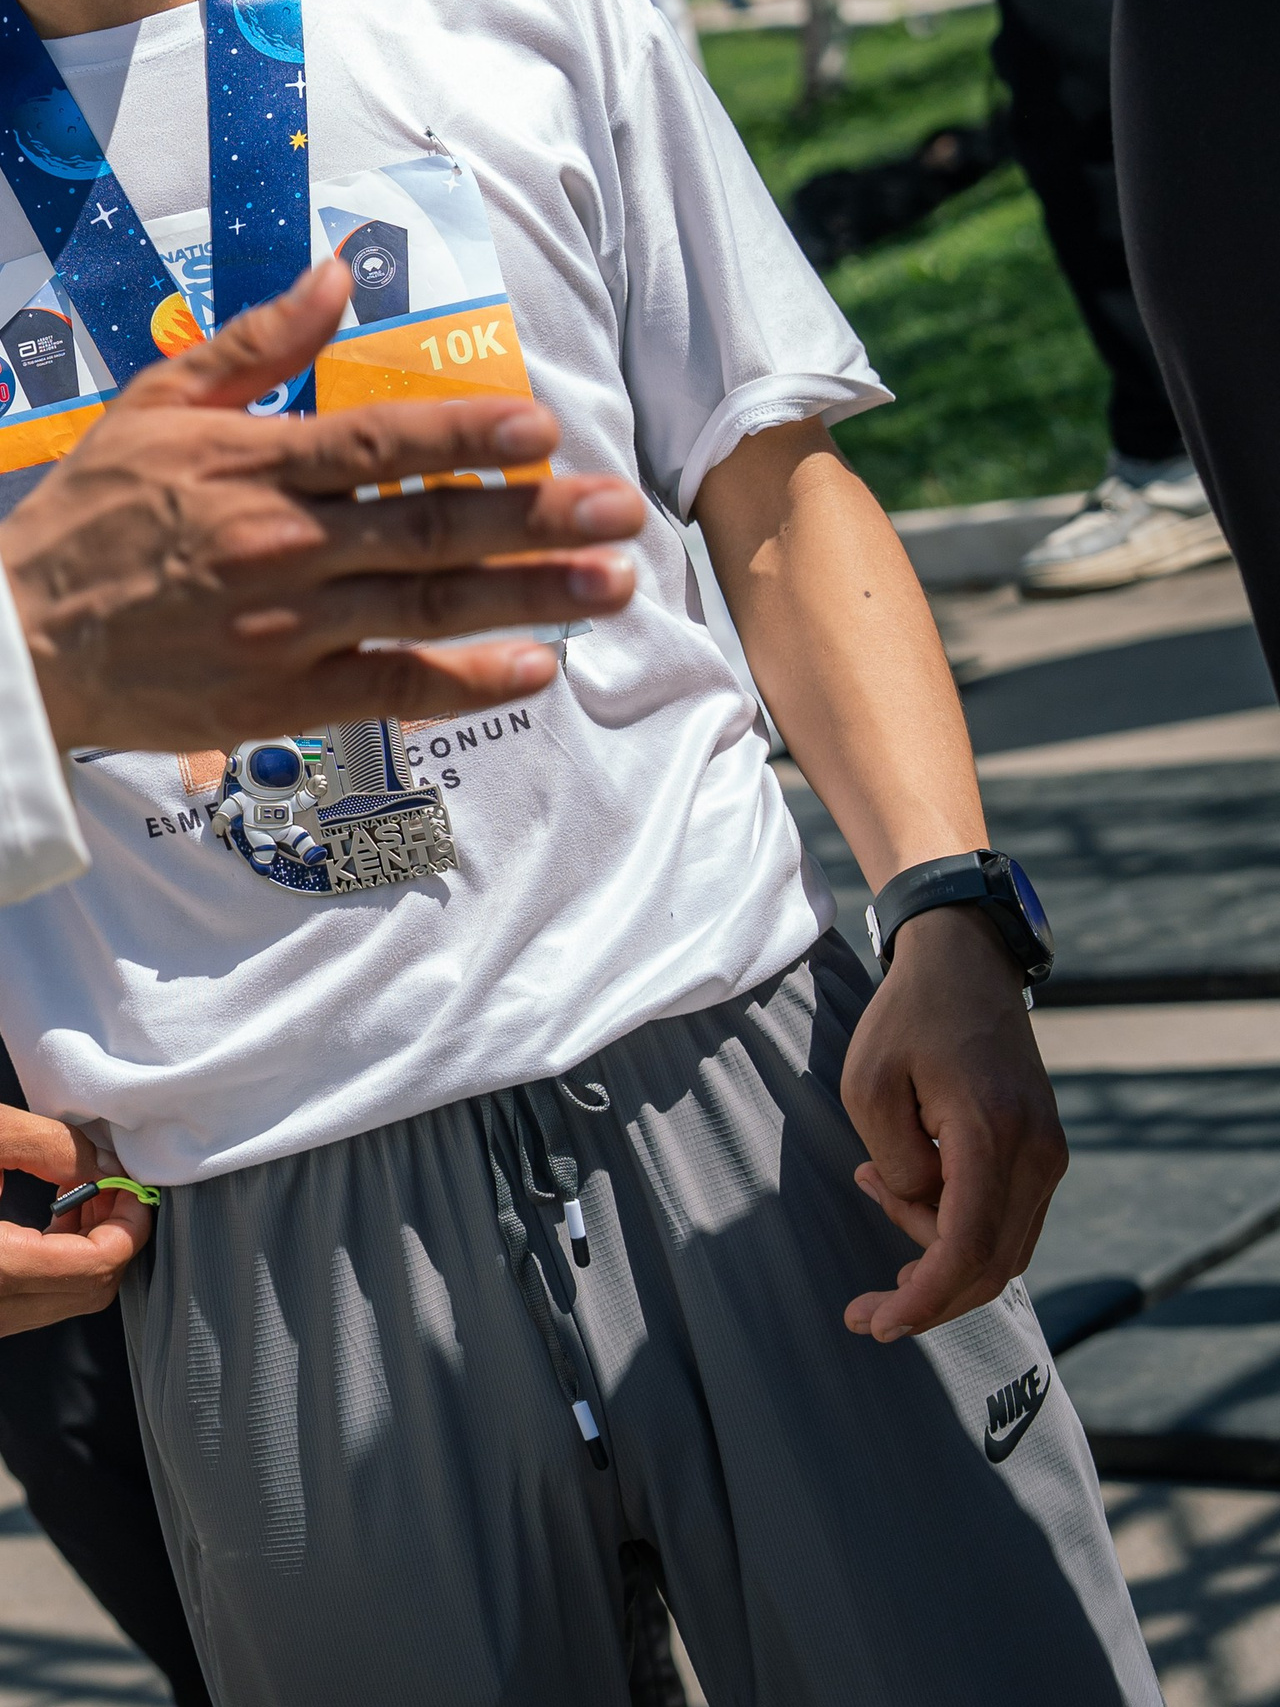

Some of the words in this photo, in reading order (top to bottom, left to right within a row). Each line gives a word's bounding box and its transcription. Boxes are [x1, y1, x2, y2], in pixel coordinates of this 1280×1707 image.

[419, 320, 508, 372] 10K
[321, 807, 431, 838] INTERNATIONAL
[322, 817, 435, 860] TASH
[326, 842, 434, 884] KENT
[332, 862, 440, 894] MARATHON
[986, 1364, 1043, 1435] NIKE
